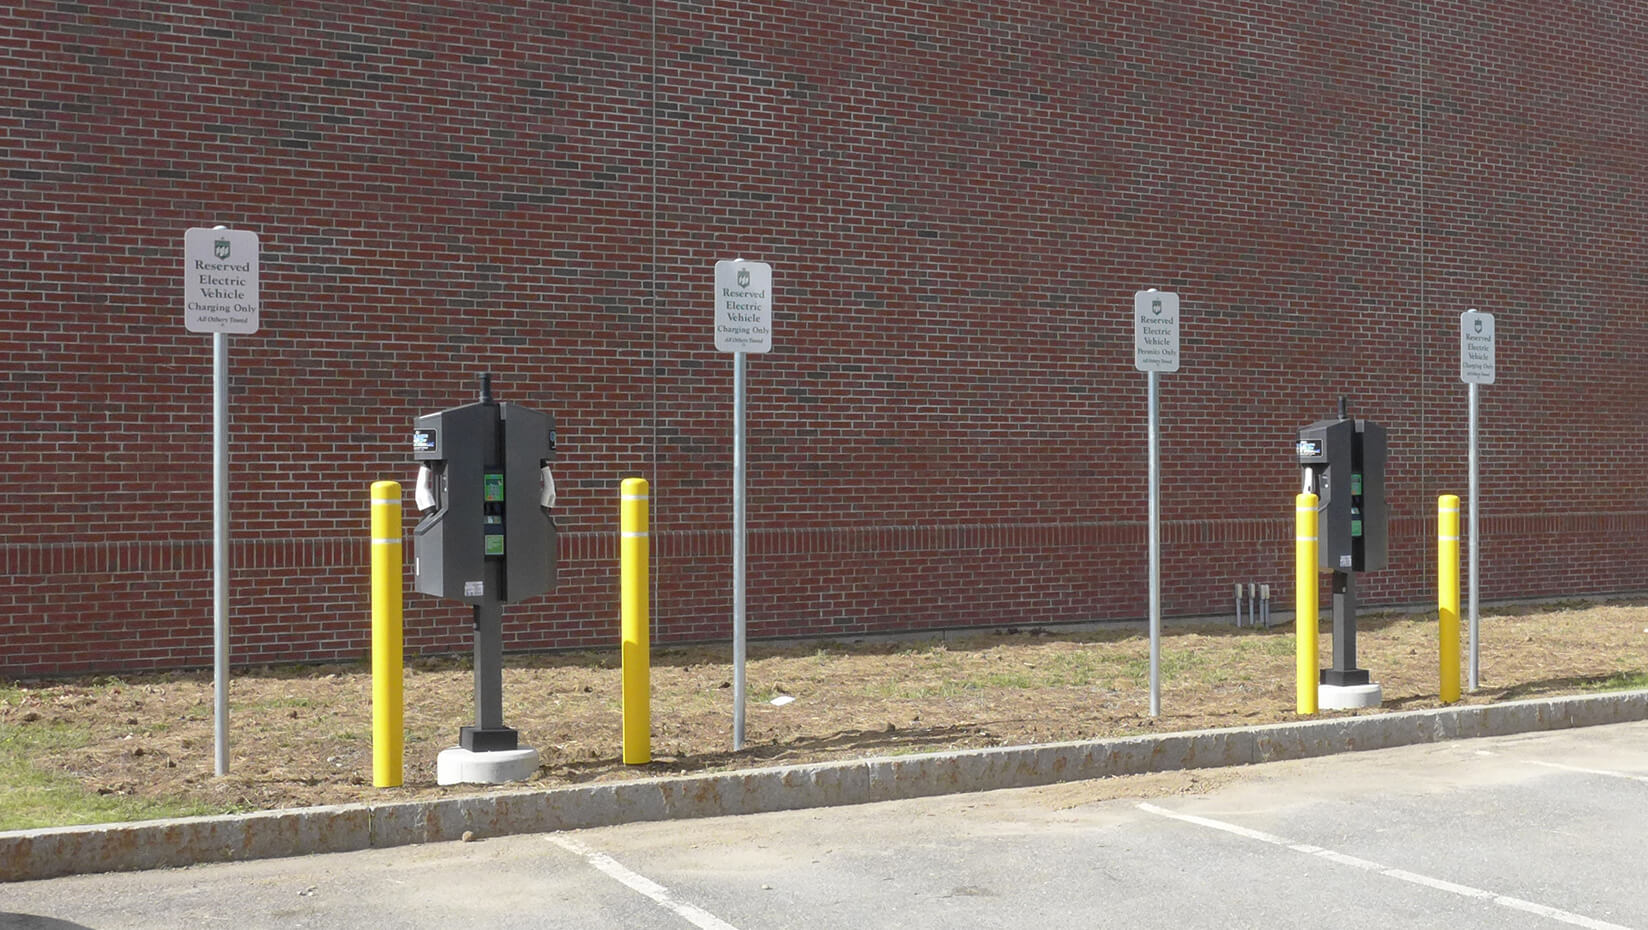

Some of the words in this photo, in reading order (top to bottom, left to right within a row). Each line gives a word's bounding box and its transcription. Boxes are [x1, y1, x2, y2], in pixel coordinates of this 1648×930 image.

[195, 260, 250, 272] Reserved
[199, 275, 246, 286] Electric
[200, 288, 245, 299] Vehicle
[722, 288, 765, 299] Reserved
[188, 302, 230, 313] Charging
[234, 304, 256, 313] Only
[726, 301, 762, 311] Electric
[727, 312, 761, 323] Vehicle
[1140, 315, 1174, 325] Reserved
[717, 325, 751, 334] Charging
[1143, 326, 1172, 335] Electric
[1144, 336, 1171, 346] Vehicle
